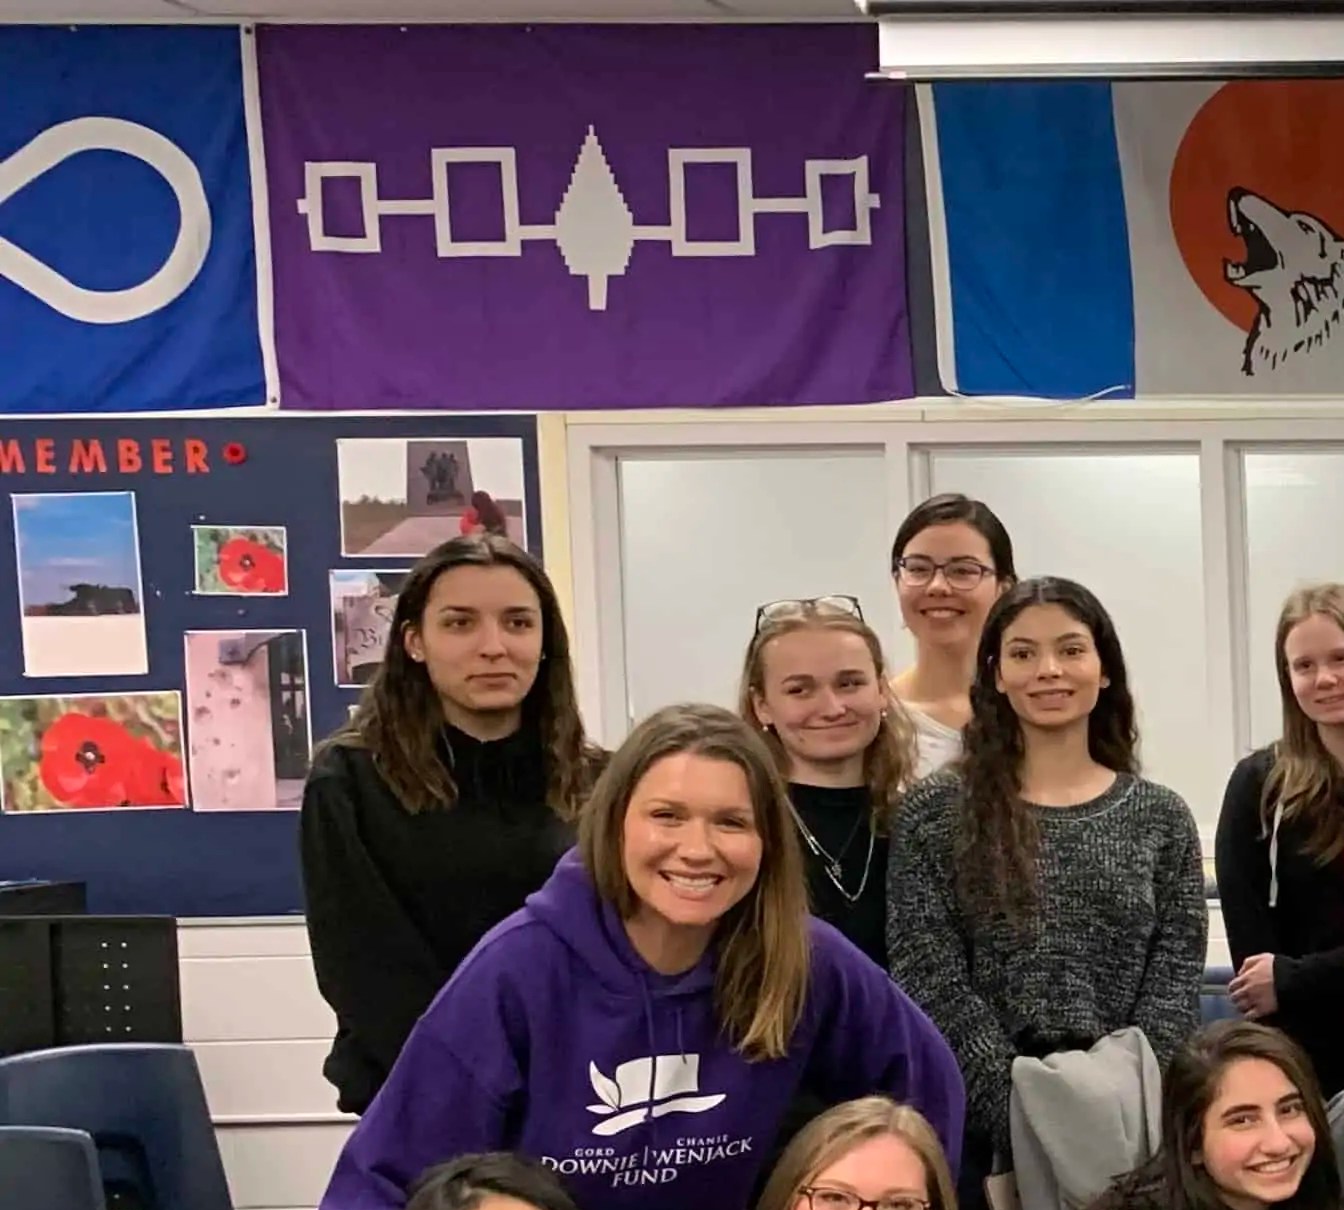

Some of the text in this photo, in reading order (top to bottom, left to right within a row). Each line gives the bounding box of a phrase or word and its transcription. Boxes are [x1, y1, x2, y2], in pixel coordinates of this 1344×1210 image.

[0, 438, 210, 474] MEMBER
[541, 1137, 753, 1175] DOWNIE WENJACK
[574, 1134, 729, 1157] GORD CHANIE
[612, 1167, 678, 1188] FUND
